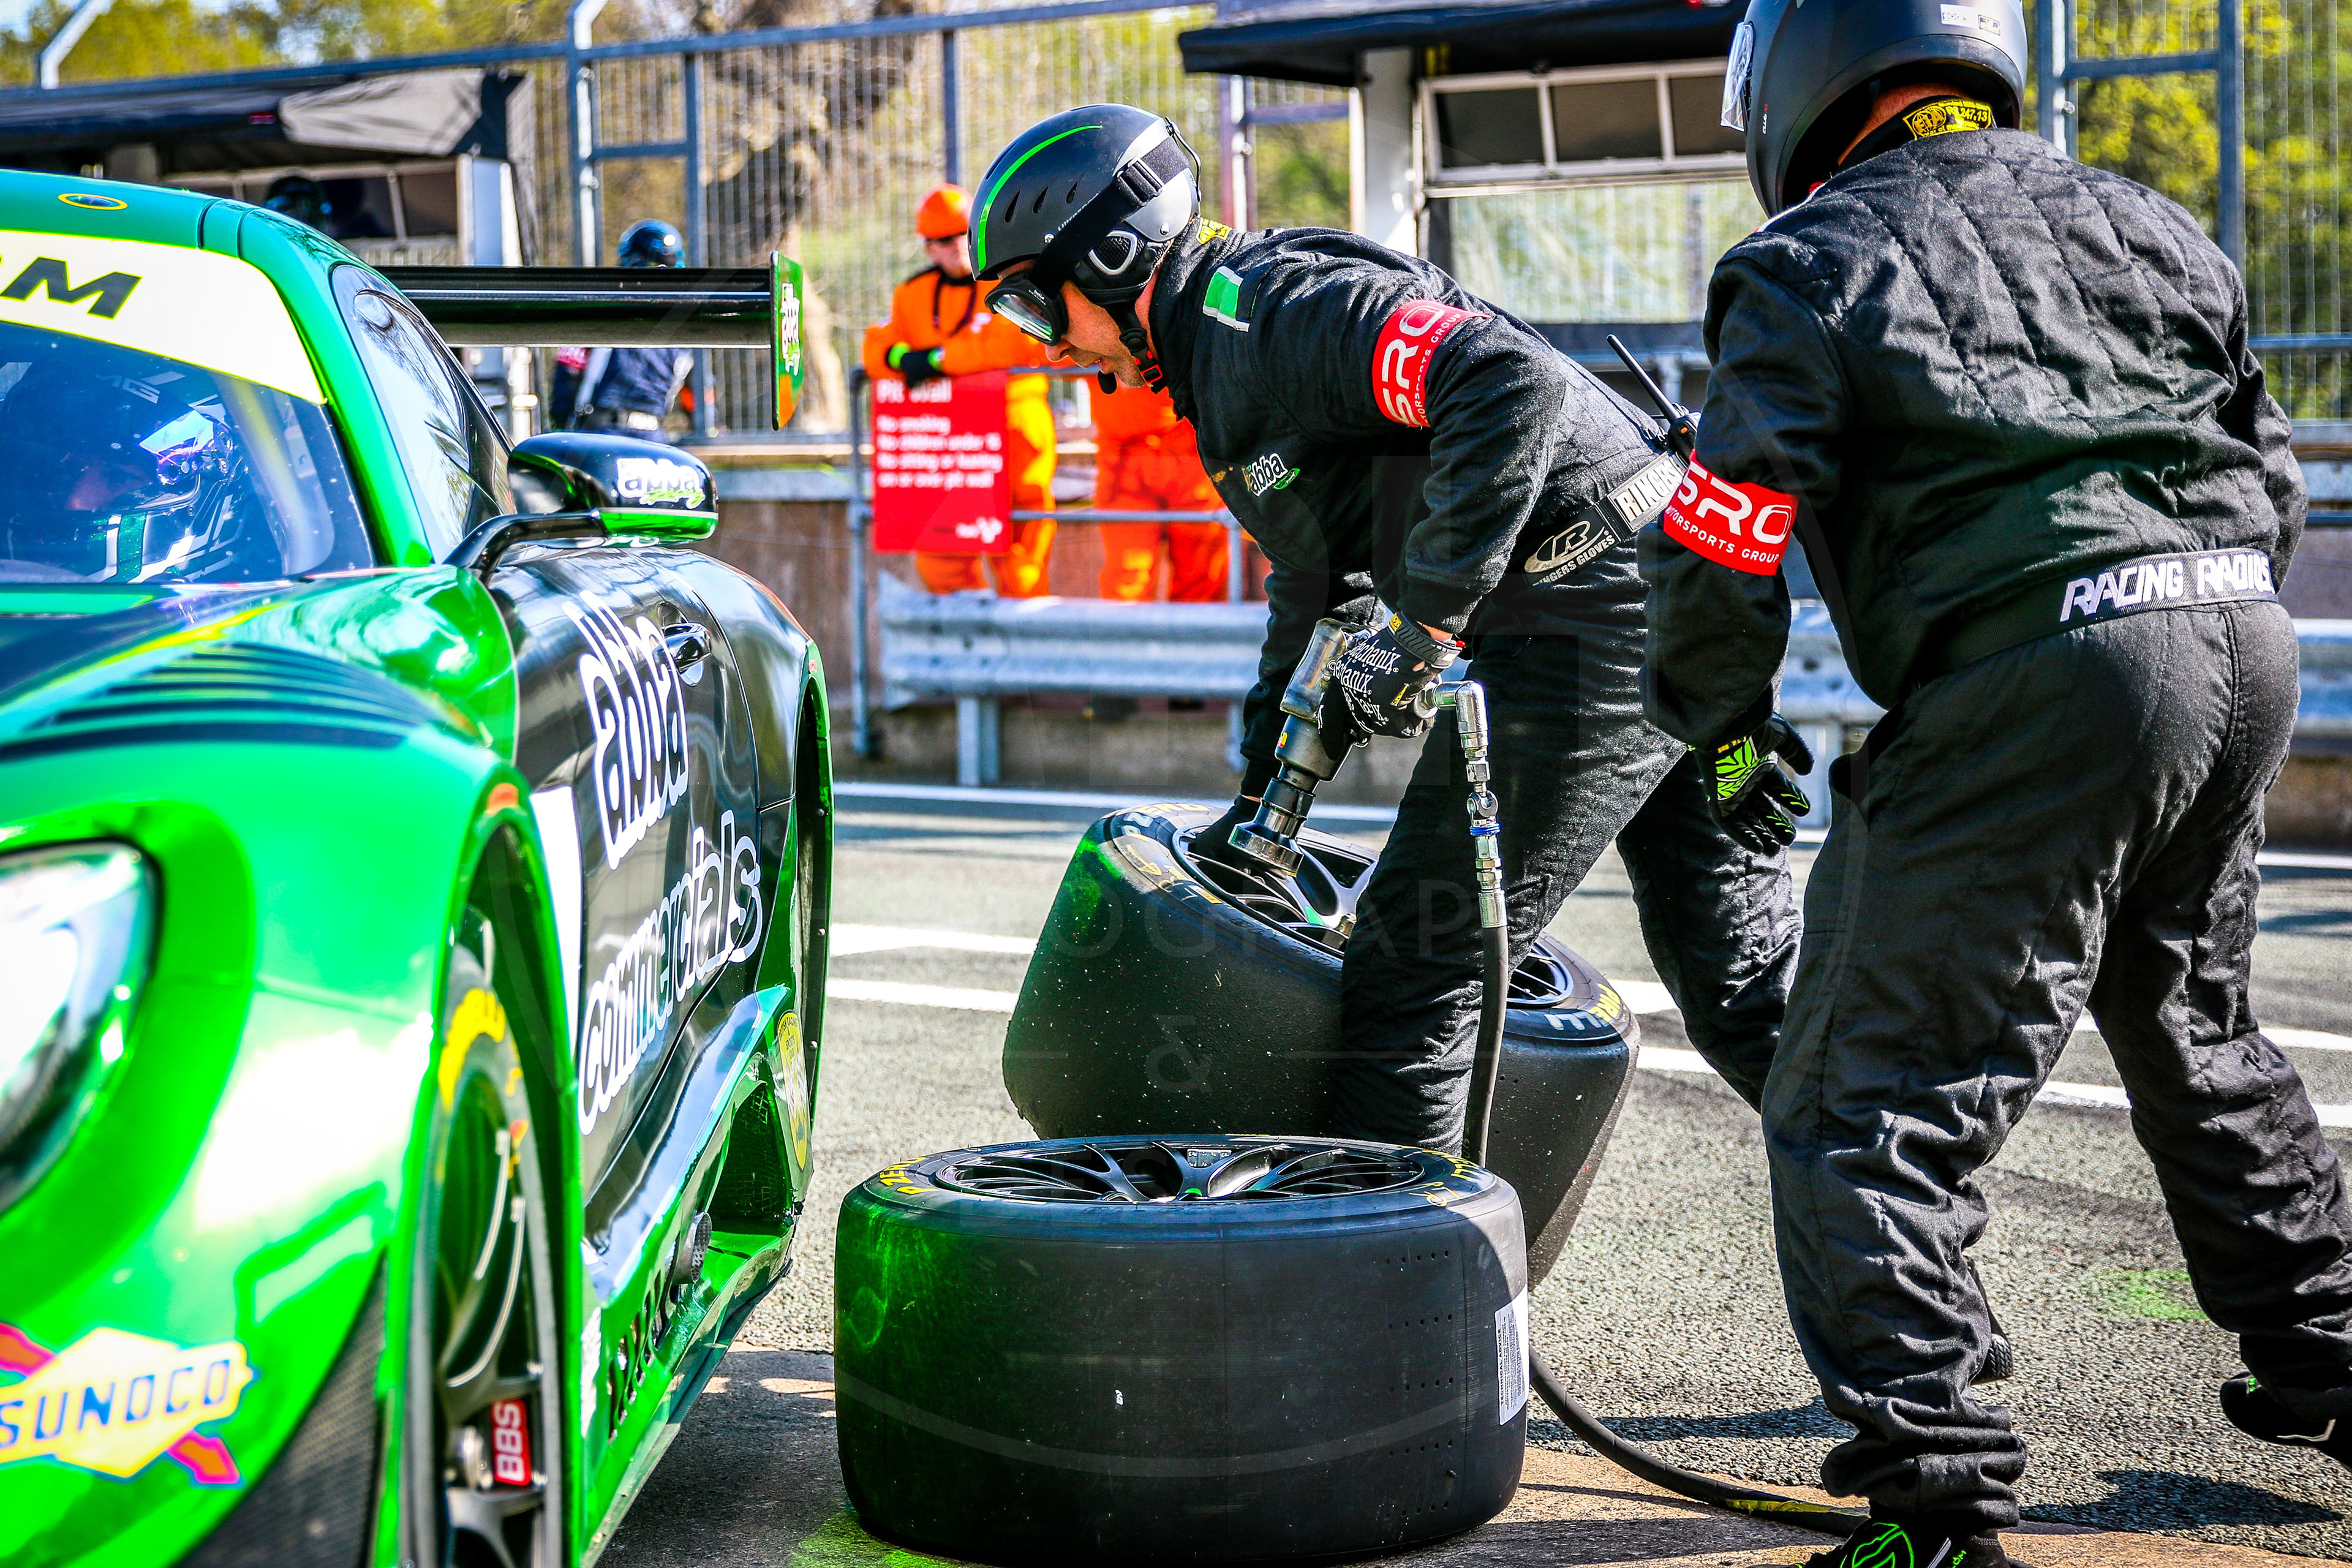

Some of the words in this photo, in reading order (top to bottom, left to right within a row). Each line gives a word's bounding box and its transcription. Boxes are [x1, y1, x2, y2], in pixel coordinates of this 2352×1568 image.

[0, 255, 143, 321] M
[1430, 313, 1461, 344] GROUP
[1381, 305, 1445, 427] SRO
[617, 458, 701, 499] abba
[1249, 453, 1288, 497] abba
[1677, 460, 1793, 545] SRO
[1534, 560, 1577, 586] INGERS
[1576, 535, 1616, 566] GLOVES
[1665, 505, 1735, 554] MOTORSPORTS
[1741, 548, 1779, 564] GROUP
[2060, 560, 2184, 622] RACING
[2196, 554, 2276, 595] RADIUS
[562, 589, 688, 870] abba
[578, 809, 762, 1135] commercials
[1544, 983, 1622, 1031] PIRELLI
[0, 1358, 231, 1449] SUNOCO
[494, 1401, 525, 1483] BBS
